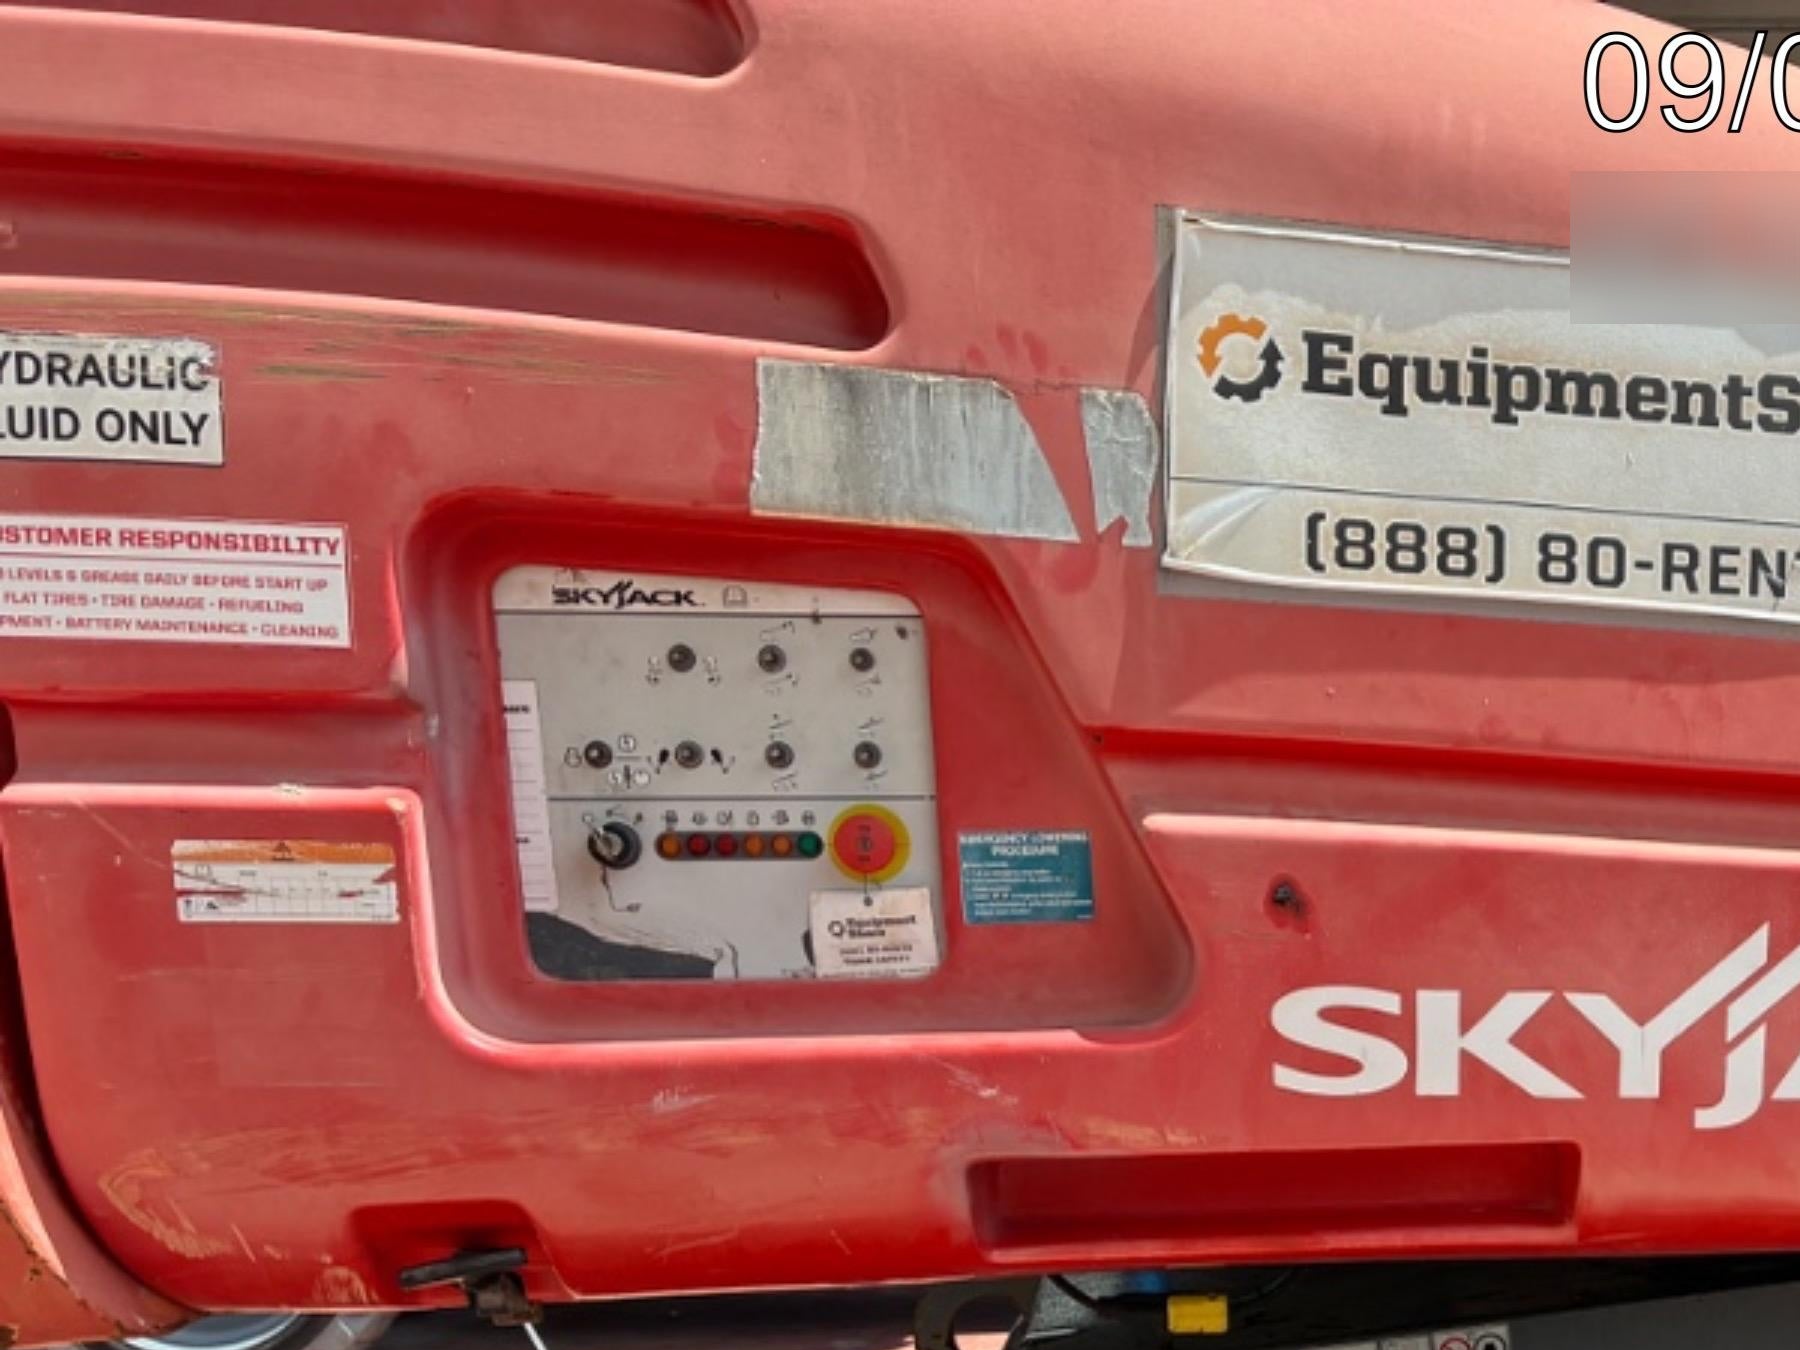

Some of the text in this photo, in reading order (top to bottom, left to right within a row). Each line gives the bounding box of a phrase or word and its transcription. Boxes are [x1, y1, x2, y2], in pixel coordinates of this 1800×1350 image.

[0, 404, 209, 446] UID ONLY
[0, 525, 340, 556] STOMER RESPONSIBILITY
[1304, 511, 1507, 583] (888)
[8, 567, 63, 582] LEVELS
[81, 570, 139, 584] GREASE
[144, 572, 188, 587] DAILY
[192, 574, 252, 589] BEFORE
[255, 576, 304, 592] START
[306, 578, 328, 592] UP
[552, 579, 698, 609] SKYJACK
[4, 591, 304, 614] FLAT TIRES TIRE DAMAGE REFUELING
[66, 616, 132, 632] BATTERY
[136, 619, 248, 635] MAINTENANCE
[260, 623, 340, 639] CLEANING
